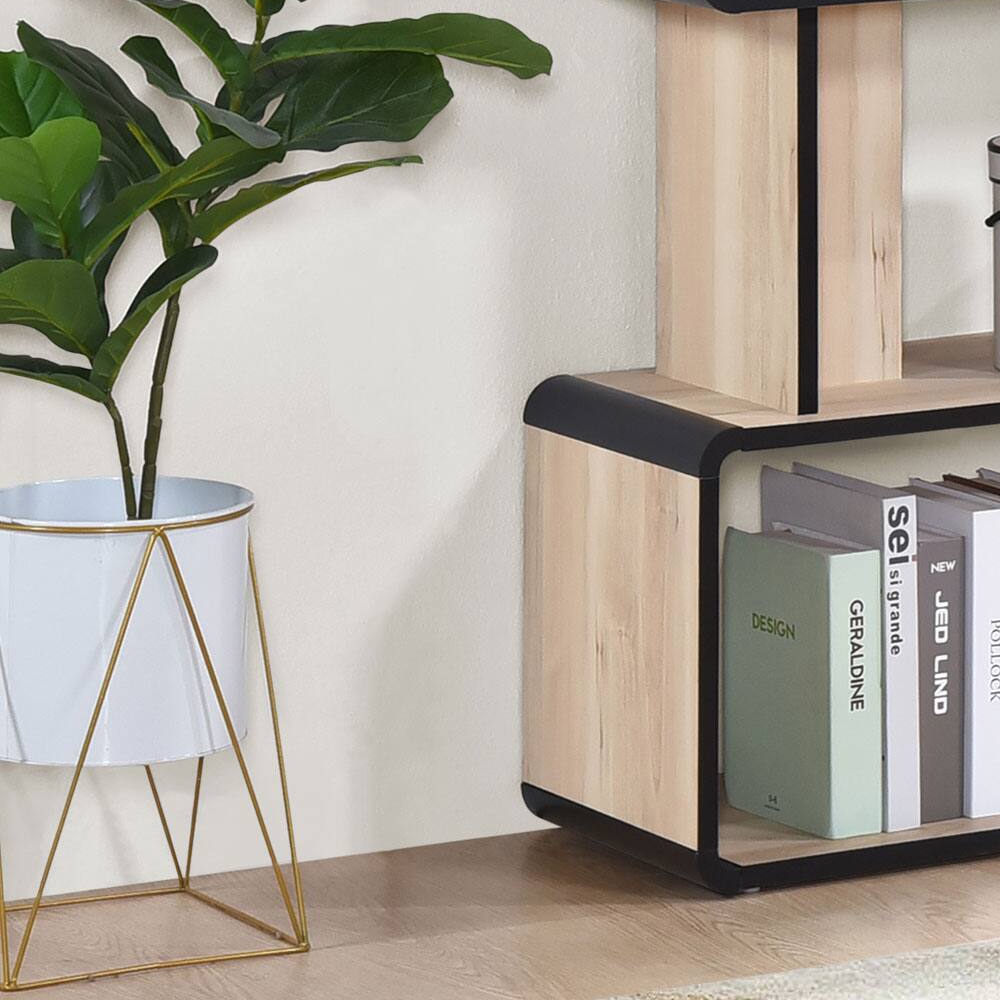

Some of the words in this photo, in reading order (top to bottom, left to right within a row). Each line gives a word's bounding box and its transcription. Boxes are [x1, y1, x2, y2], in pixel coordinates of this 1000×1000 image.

[889, 570, 903, 585] si
[930, 560, 957, 573] NEW
[751, 612, 796, 640] DESIGN
[887, 591, 904, 655] grande
[934, 591, 949, 644] JED
[850, 600, 865, 712] GERALDINE
[934, 654, 949, 716] LIND
